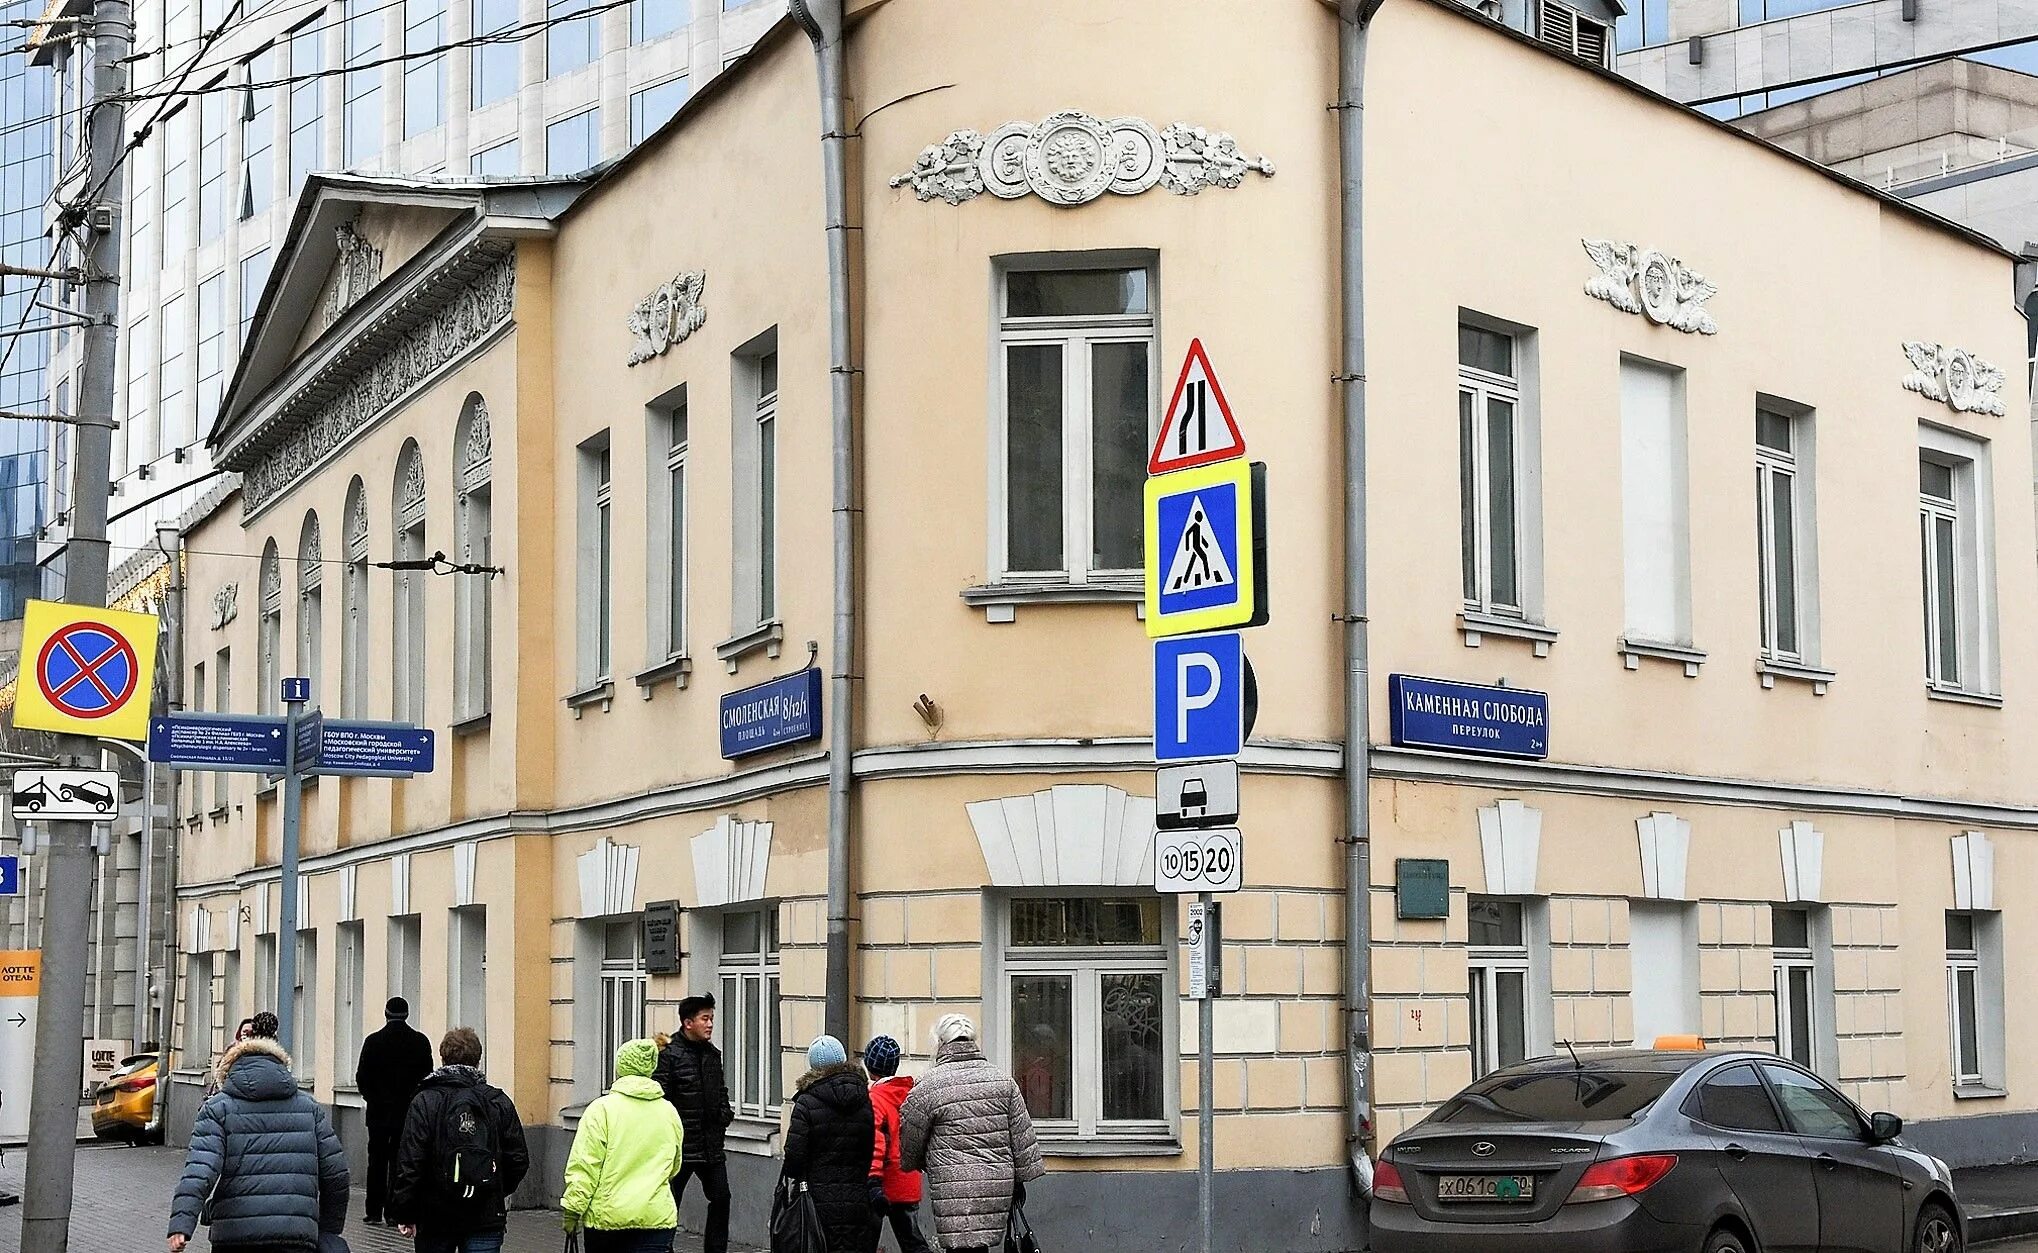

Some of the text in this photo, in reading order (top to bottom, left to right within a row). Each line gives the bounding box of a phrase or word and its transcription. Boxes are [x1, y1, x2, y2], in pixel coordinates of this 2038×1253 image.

[1177, 652, 1222, 744] P
[723, 691, 807, 729] СМОЛЕНСКАЯ 8/12/1
[1406, 691, 1544, 727] КАМЕННАЯ СЛОБОДА
[737, 725, 765, 741] ПЛОЩАДЬ
[1452, 723, 1501, 739] ПЕРЕУЛОК
[368, 740, 402, 748] городской
[1164, 847, 1228, 873] 10 15 20
[2, 966, 35, 974] ЛОТТЕ
[2, 974, 34, 982] ОТЕЛЬ
[92, 1050, 115, 1062] LOTTE
